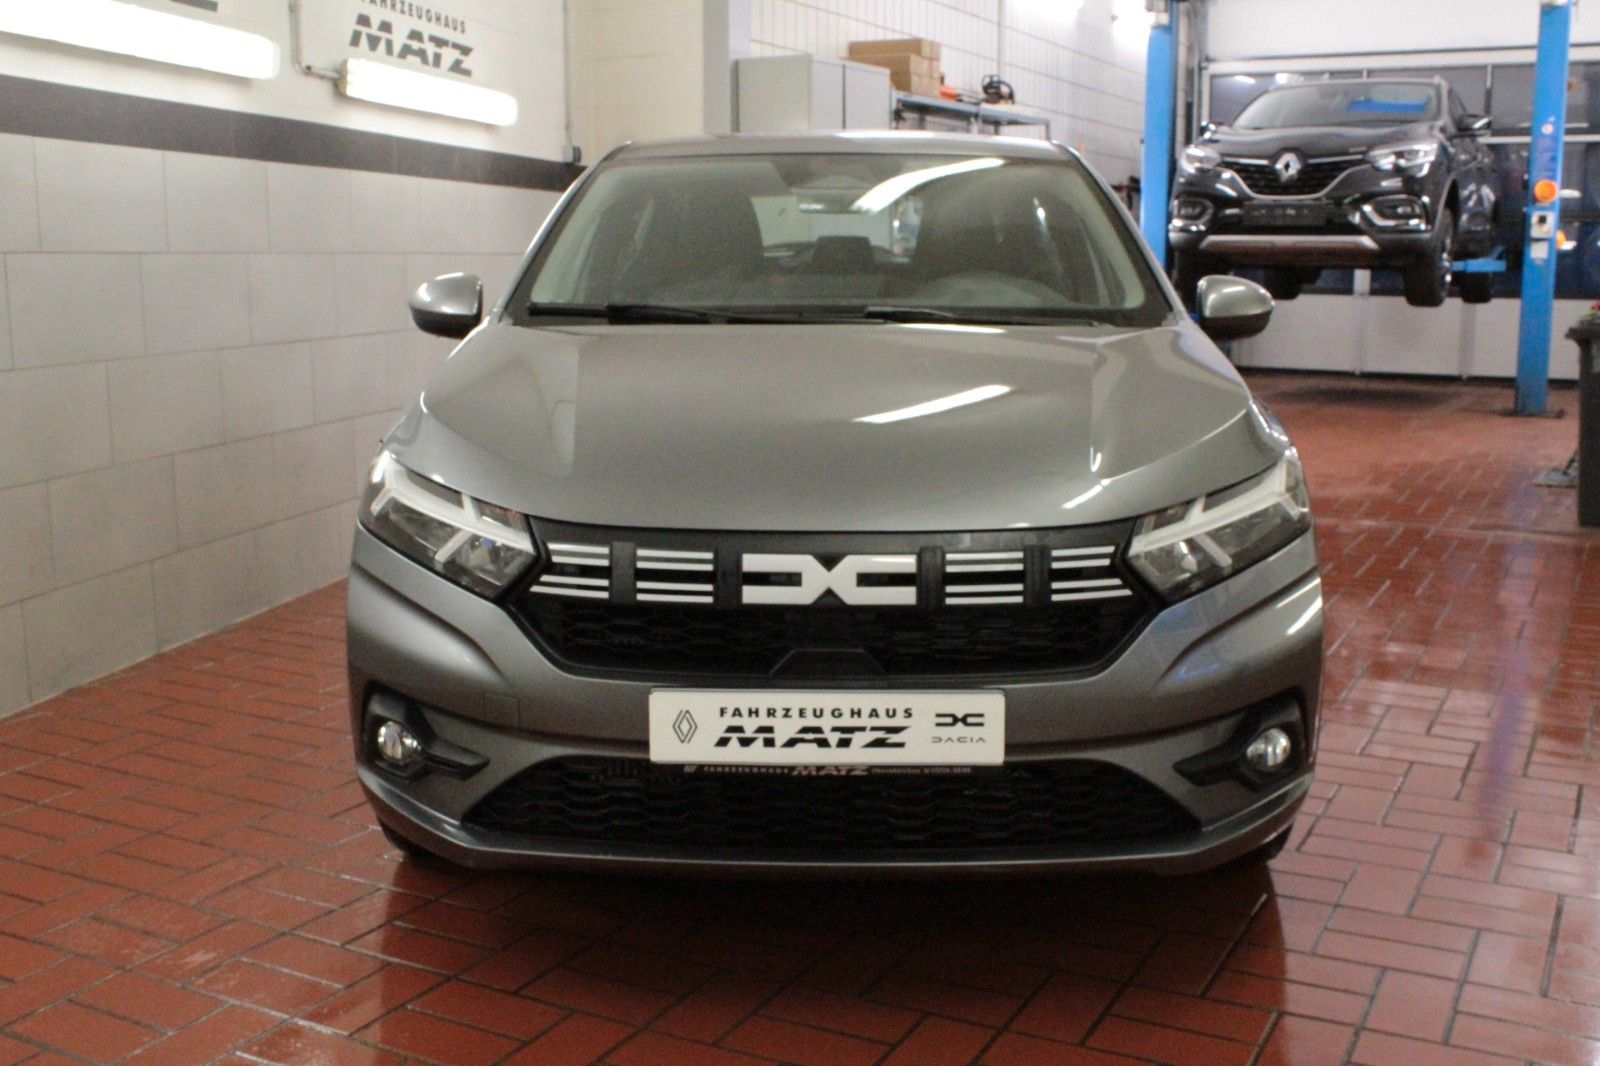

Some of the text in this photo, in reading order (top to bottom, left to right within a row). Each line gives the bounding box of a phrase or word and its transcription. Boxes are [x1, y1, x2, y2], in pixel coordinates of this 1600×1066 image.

[362, 0, 466, 34] HRZEUGHAUS
[349, 12, 474, 77] MATZ
[719, 707, 913, 719] FAHRZEUGHAUS
[713, 725, 911, 748] MATZ
[931, 736, 986, 744] DACIA
